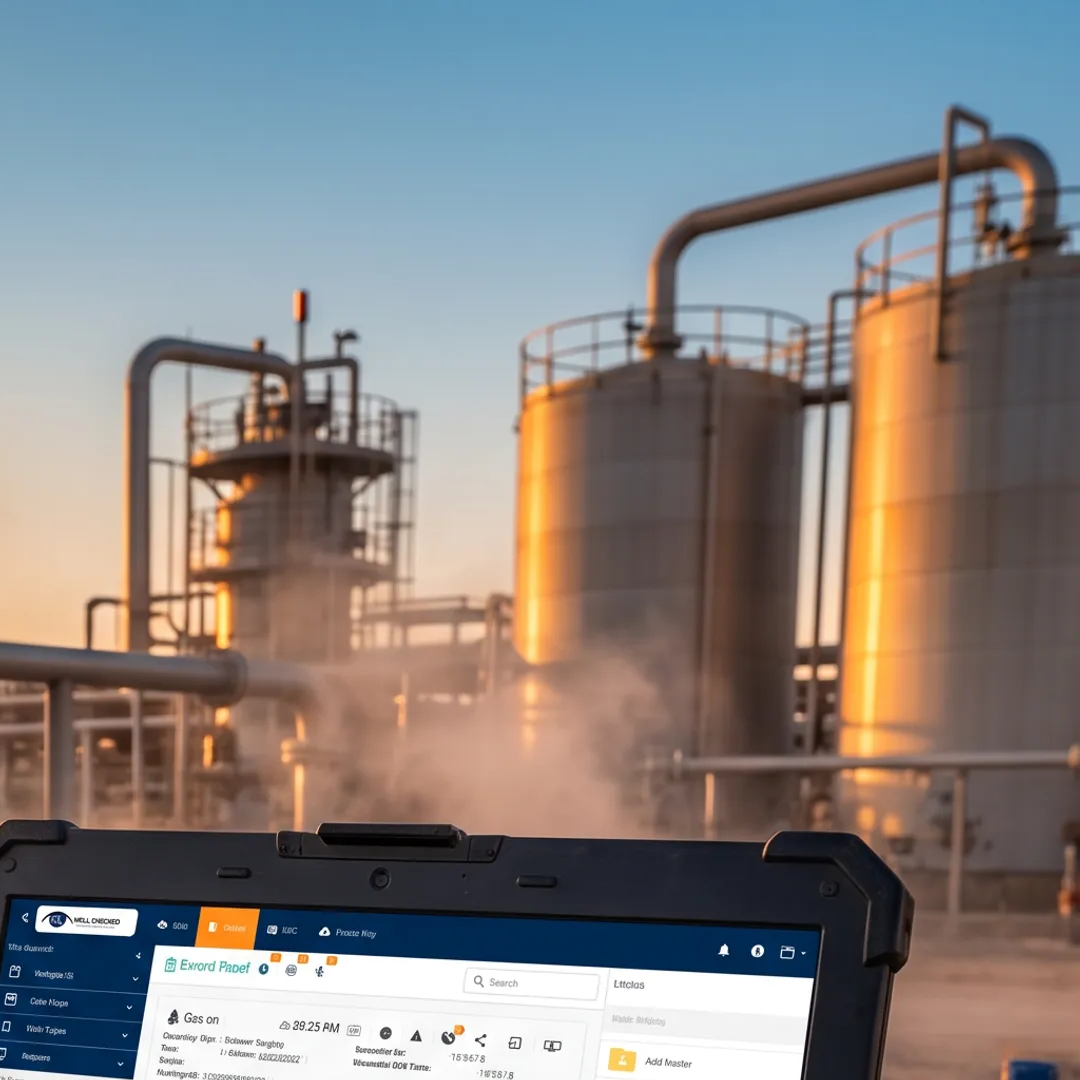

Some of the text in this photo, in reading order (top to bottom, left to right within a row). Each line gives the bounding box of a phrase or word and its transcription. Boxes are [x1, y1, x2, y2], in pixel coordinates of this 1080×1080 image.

[489, 978, 519, 988] Search
[206, 1015, 219, 1025] on
[645, 1057, 692, 1069] Add Master
